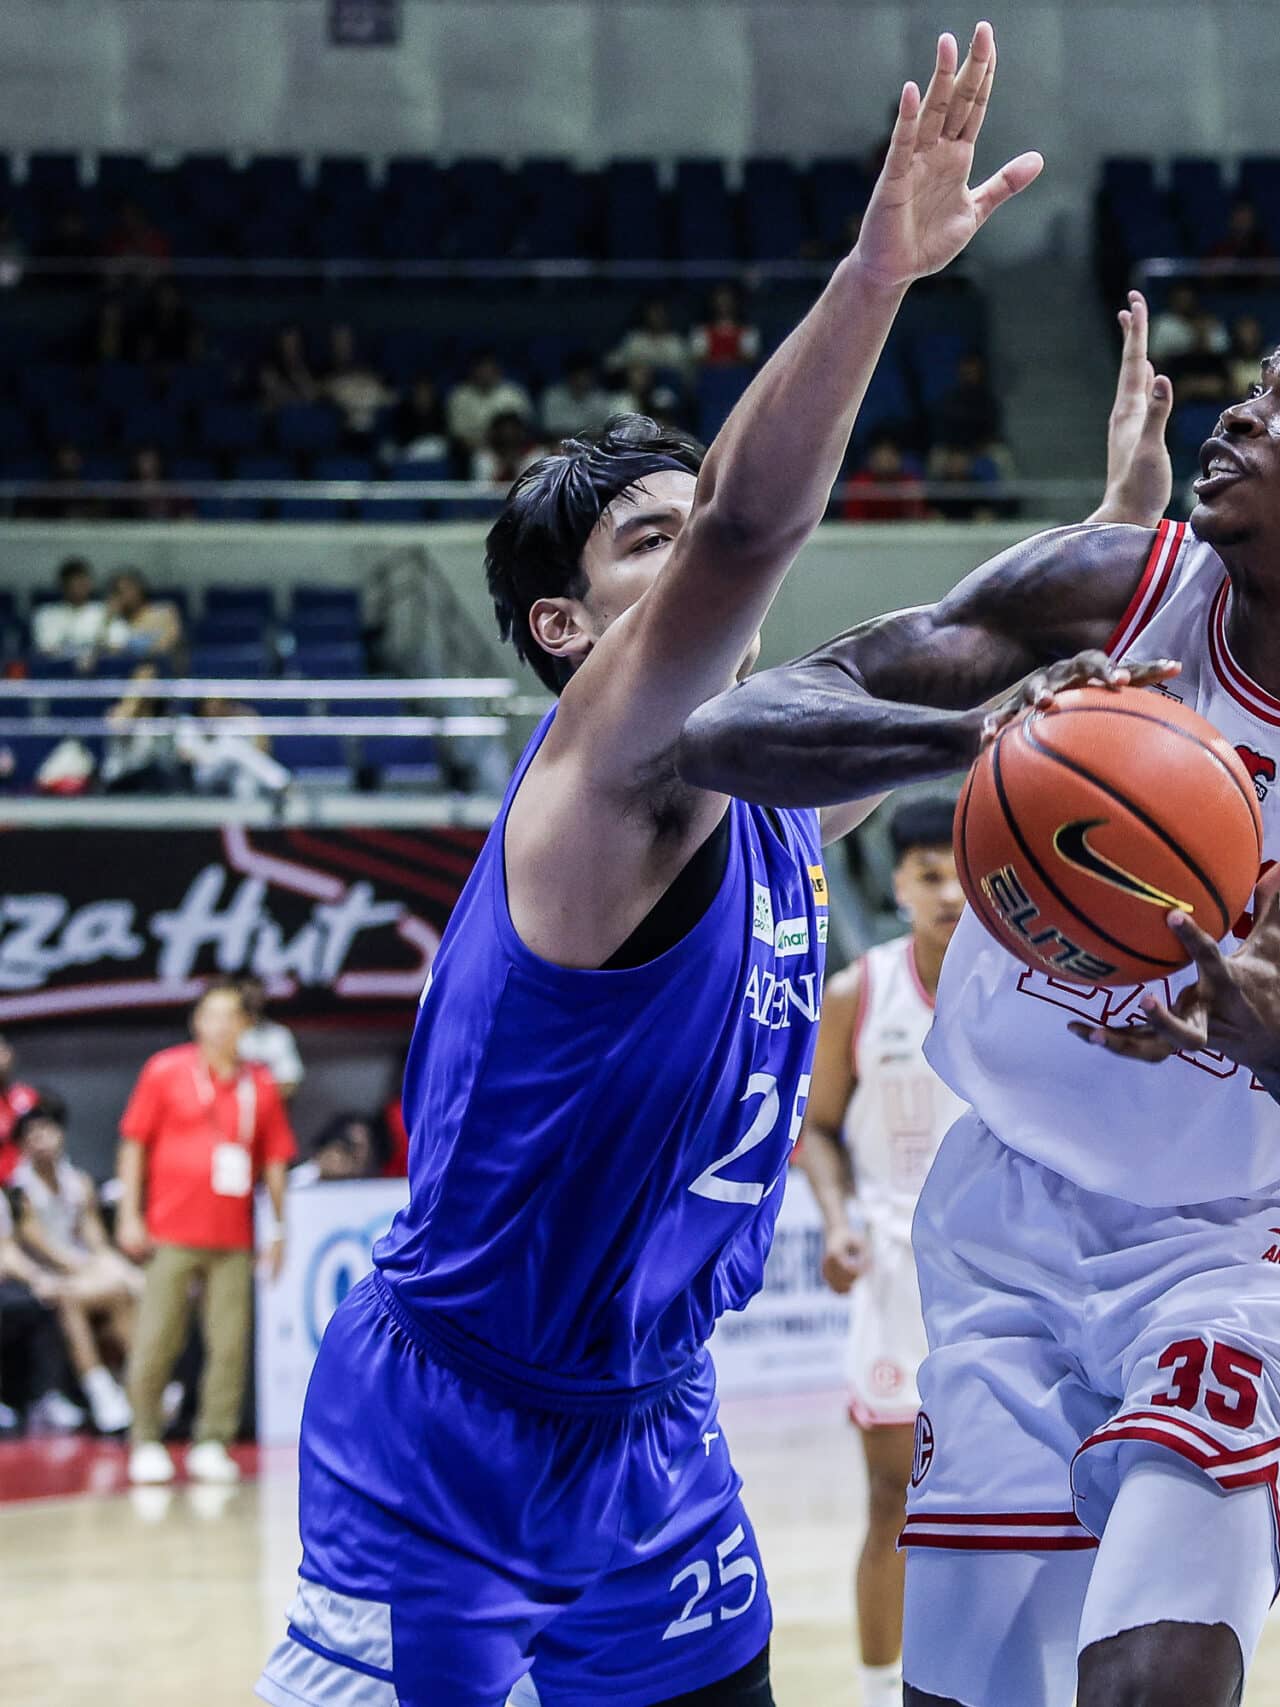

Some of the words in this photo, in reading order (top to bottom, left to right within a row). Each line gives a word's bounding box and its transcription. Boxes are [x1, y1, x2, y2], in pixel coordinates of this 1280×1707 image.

[149, 863, 404, 988] Hut
[980, 863, 1120, 981] ELITE
[1150, 1336, 1263, 1430] 35
[662, 1523, 758, 1641] 25
